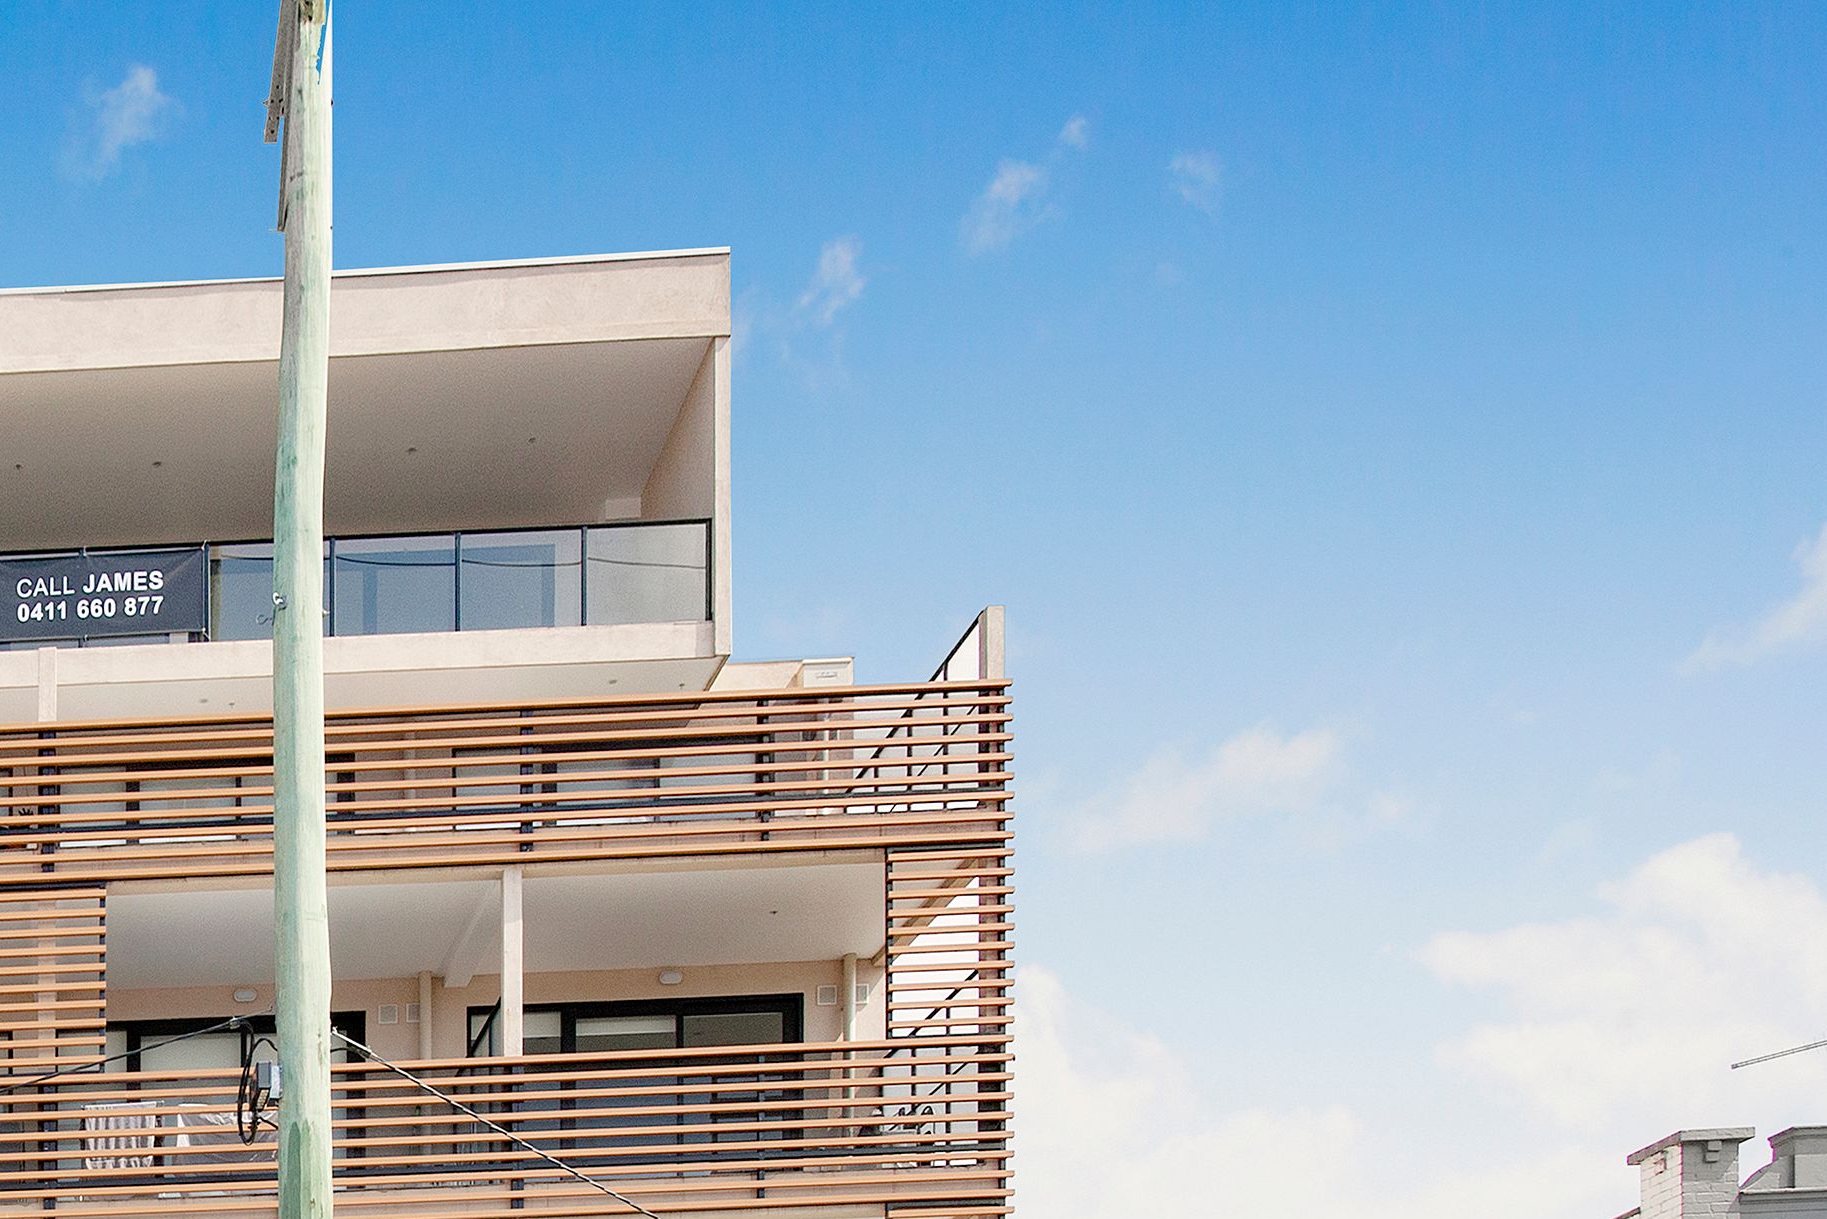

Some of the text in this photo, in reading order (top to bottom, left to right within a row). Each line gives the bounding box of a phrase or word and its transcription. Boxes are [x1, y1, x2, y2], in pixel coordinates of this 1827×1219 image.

[16, 570, 164, 599] CALL JAMES
[17, 595, 164, 622] 0411 660 877
